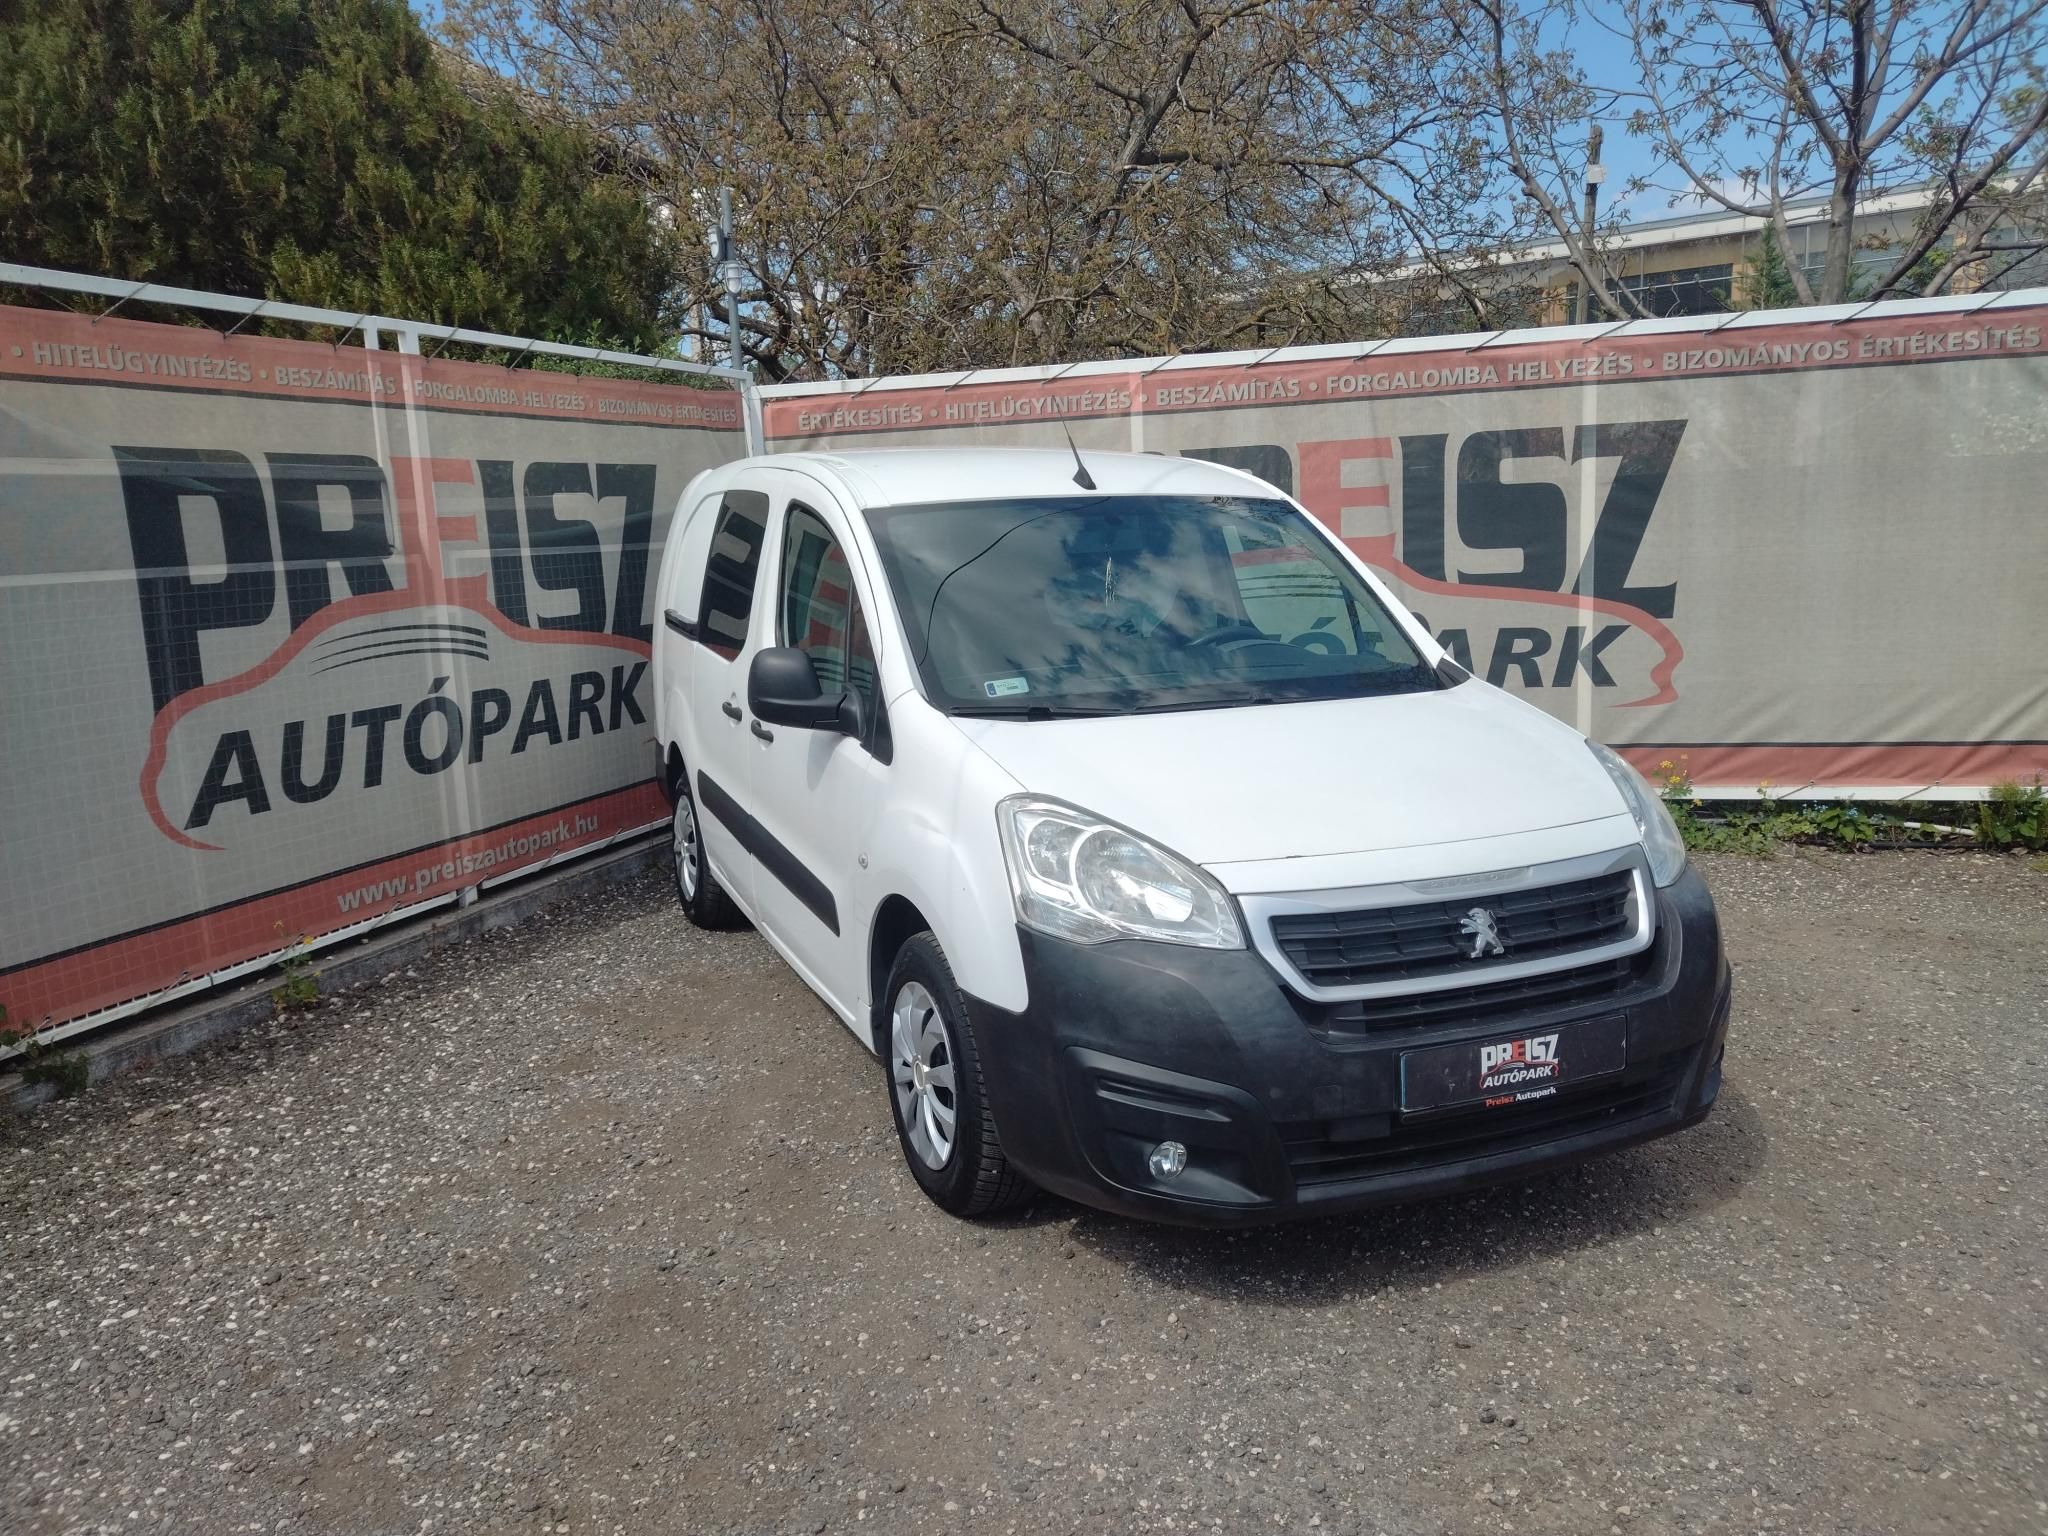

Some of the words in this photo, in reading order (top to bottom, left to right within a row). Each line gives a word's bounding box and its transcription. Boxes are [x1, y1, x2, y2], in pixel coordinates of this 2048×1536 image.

[32, 342, 252, 383] HITELÜGYINTÉZÉS
[275, 366, 396, 395] BESZÁMÍTÁS
[414, 378, 517, 404] FORGALOMBA
[522, 390, 585, 411] HELYEZÉS
[599, 397, 673, 418] BIZOMÁNYOS
[799, 404, 923, 431] ÉRTÉKESÍTÉS
[945, 389, 1132, 420] HITELÜGYINTÉZÉS
[1156, 376, 1300, 406] BESZÁMÍTÁS
[1327, 364, 1499, 394] FORGALOMBA
[1507, 351, 1634, 382] HELYEZÉS
[1663, 339, 1850, 371] BIZOMÁNYOS
[1858, 324, 2042, 358] ÉRTÉKESÍTÉS
[1138, 419, 1688, 619] EISZ
[111, 446, 656, 715] PREISZ
[184, 660, 649, 831] AUTÓPARK
[336, 814, 600, 913] www.preiszautopark.hu
[1480, 1034, 1559, 1075] PREISZ
[1483, 1065, 1553, 1089] AUTÓPARK
[1515, 1086, 1557, 1102] Autopark
